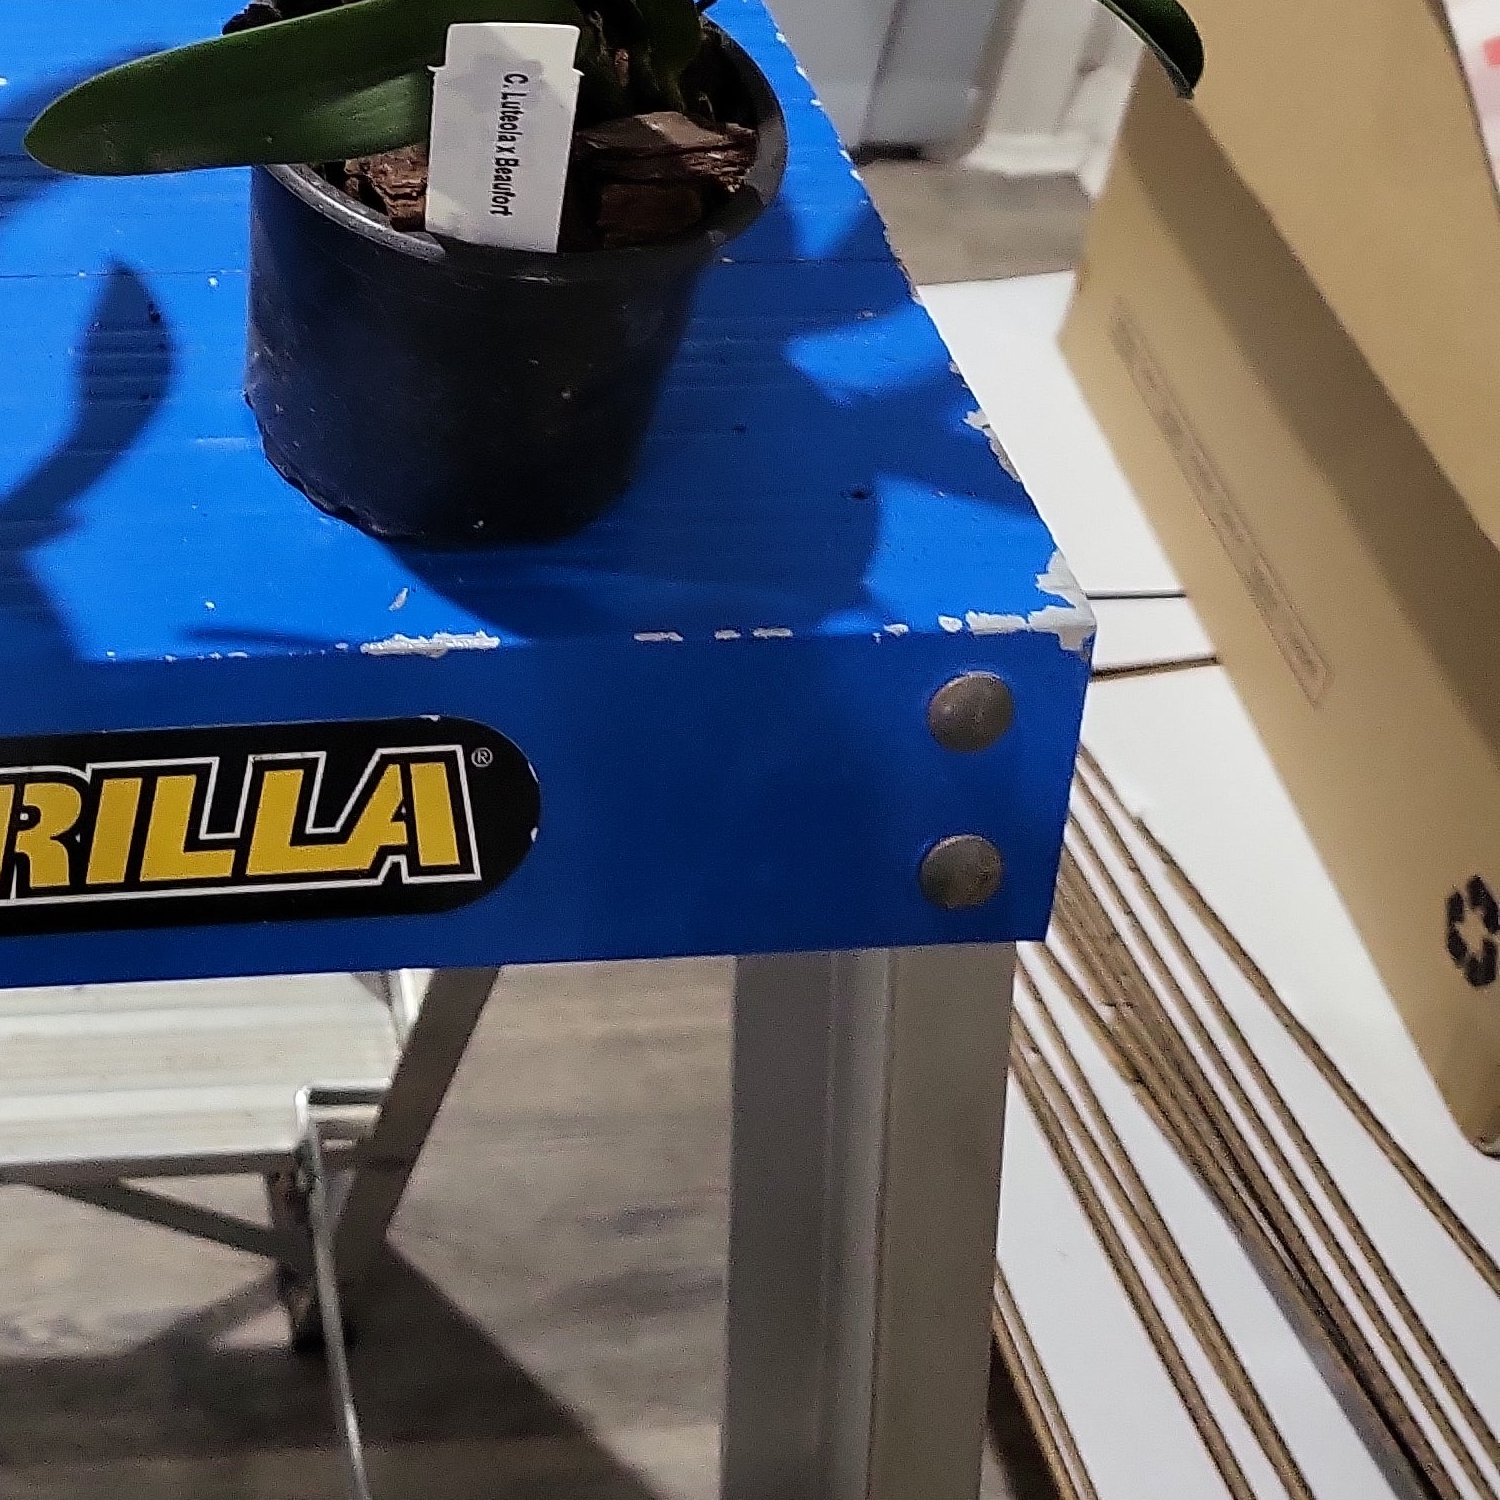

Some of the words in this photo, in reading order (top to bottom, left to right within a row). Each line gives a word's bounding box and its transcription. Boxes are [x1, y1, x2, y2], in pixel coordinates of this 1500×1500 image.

[502, 73, 529, 89] C.
[497, 91, 527, 143] Luteola
[496, 146, 516, 154] x
[489, 157, 520, 217] Beaufort
